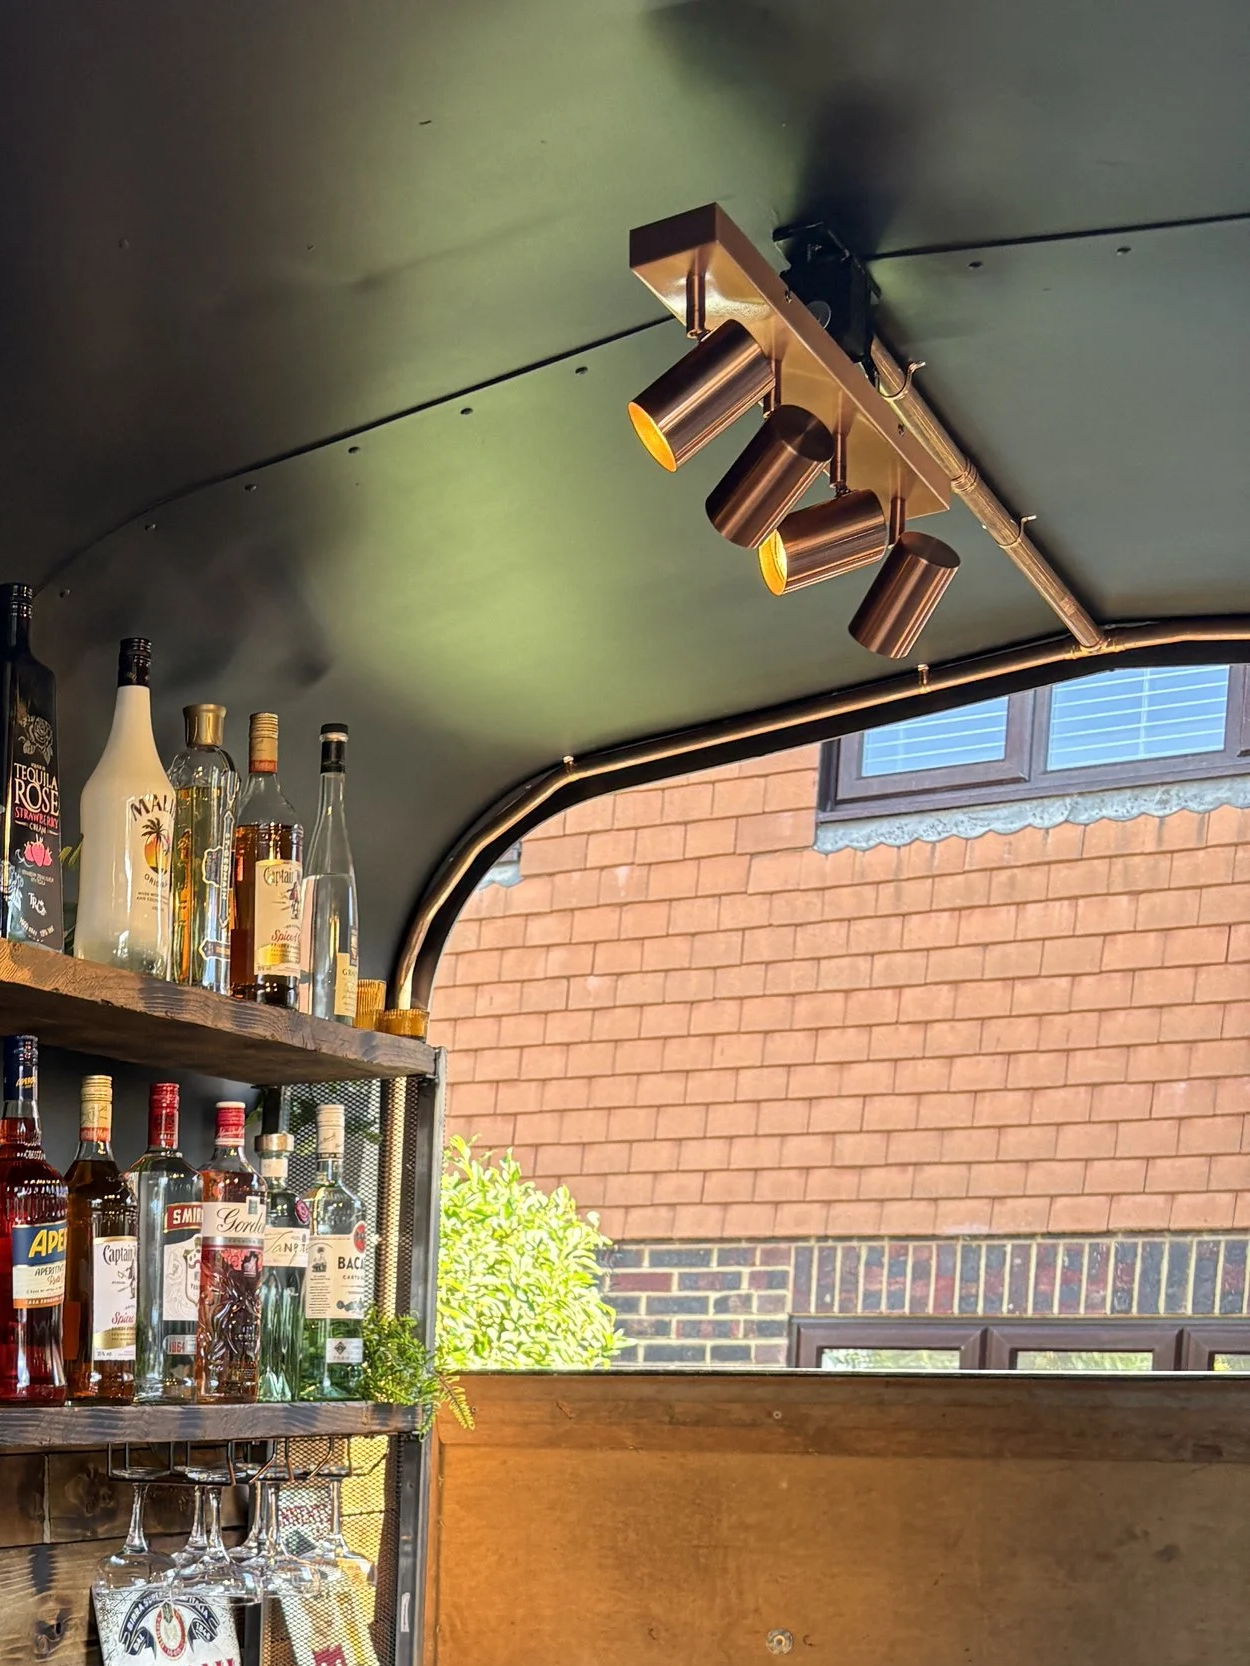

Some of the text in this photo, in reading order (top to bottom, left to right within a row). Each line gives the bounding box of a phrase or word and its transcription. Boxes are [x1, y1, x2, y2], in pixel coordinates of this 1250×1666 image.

[14, 762, 58, 791] TEQUILA
[14, 778, 59, 816] ROSE
[14, 806, 60, 830] STRAWBERRY
